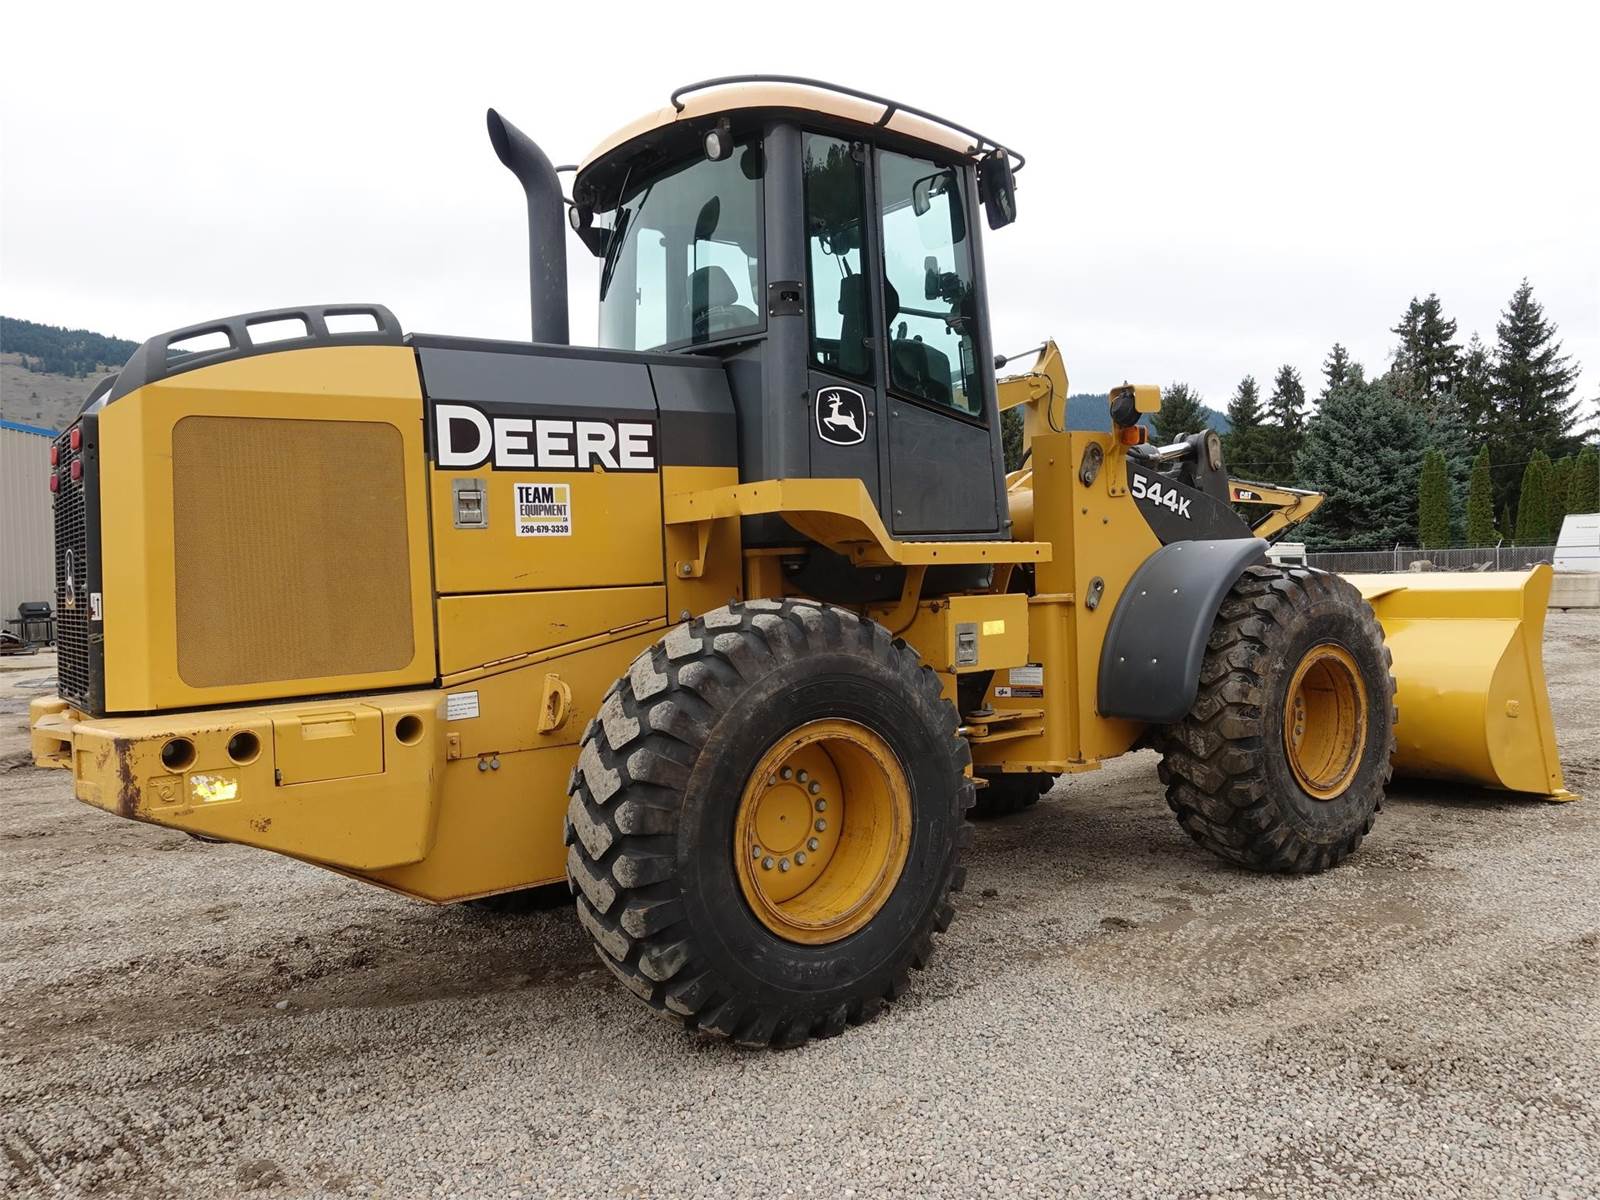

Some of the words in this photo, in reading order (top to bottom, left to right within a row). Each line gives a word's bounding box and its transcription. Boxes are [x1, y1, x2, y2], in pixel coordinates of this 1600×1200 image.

[436, 404, 655, 469] DEERE
[517, 486, 554, 504] TEAM
[1132, 473, 1192, 519] 544K
[1240, 491, 1252, 500] CAT
[520, 504, 567, 517] EQUIPMENT
[521, 524, 569, 534] 250-679-3339
